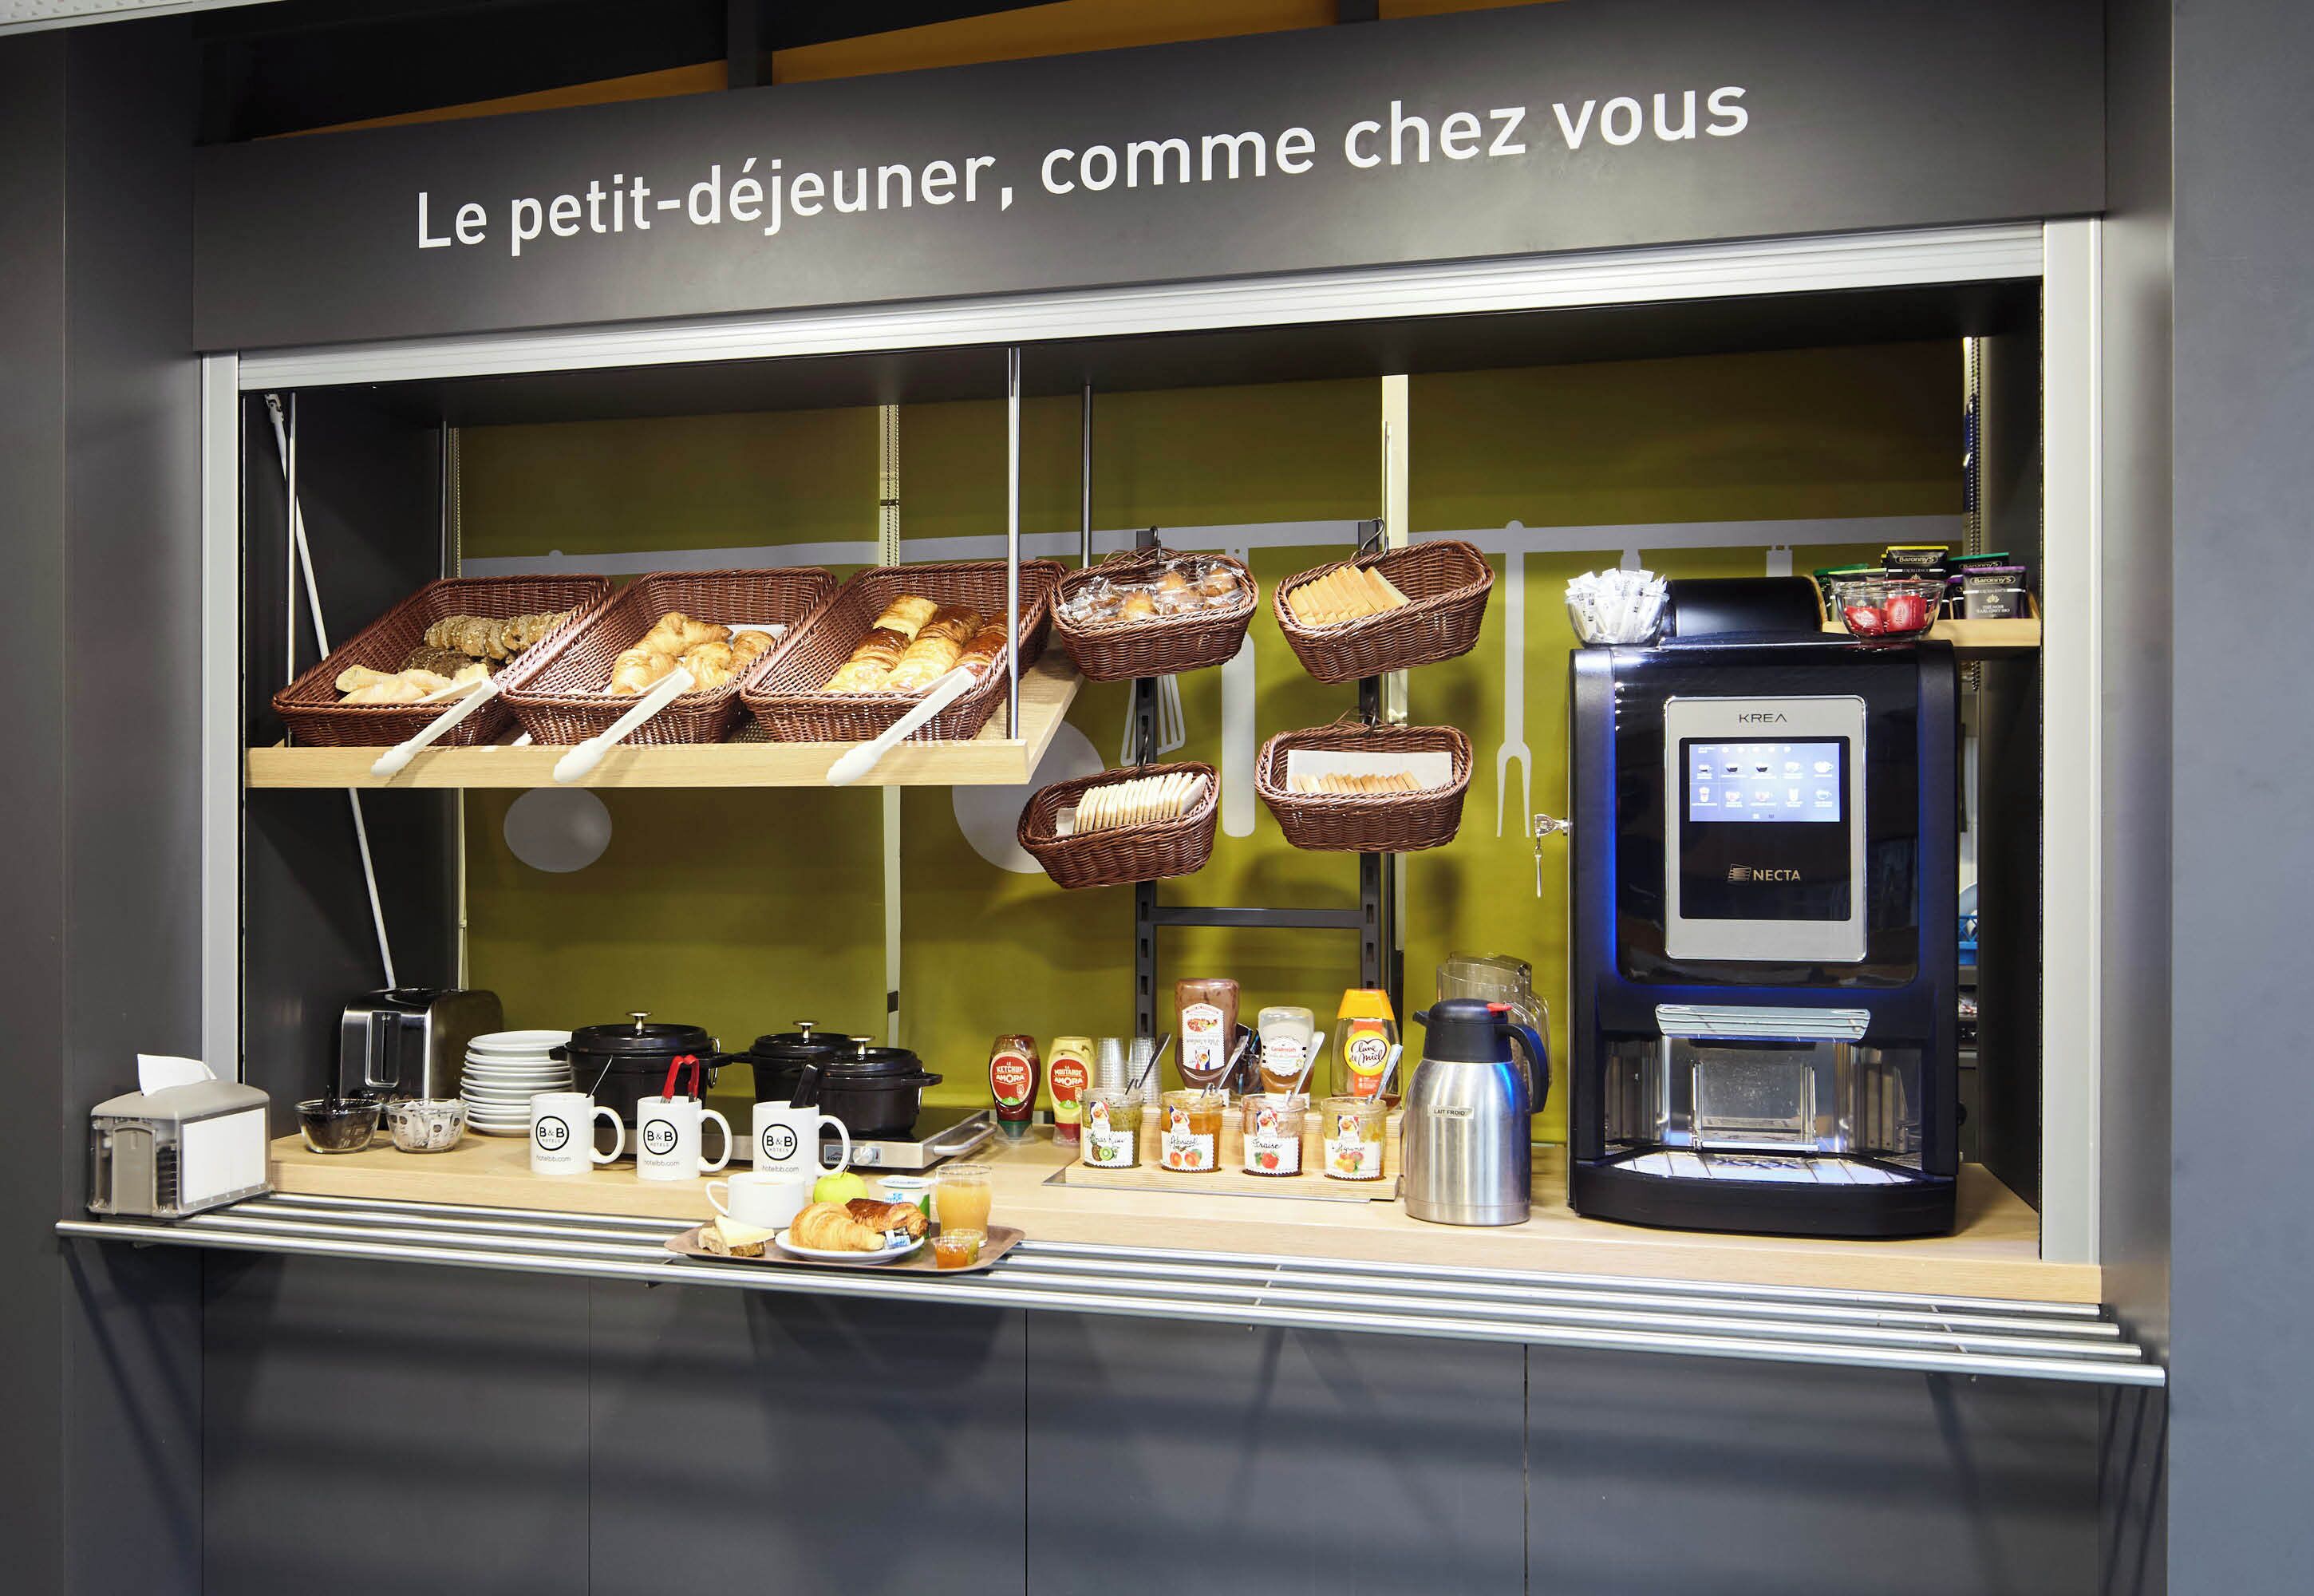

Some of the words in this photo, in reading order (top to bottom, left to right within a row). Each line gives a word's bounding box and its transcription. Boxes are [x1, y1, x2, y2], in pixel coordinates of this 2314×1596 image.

[418, 192, 487, 248] Le
[511, 156, 1013, 257] petit-déjeuner,
[1041, 127, 1316, 195] comme
[1345, 100, 1526, 168] chez
[1552, 86, 1749, 150] vous
[1739, 713, 1787, 723] KREA
[1753, 869, 1801, 881] NECTA
[996, 1074, 1025, 1084] AMORA
[1054, 1077, 1084, 1086] AMORA
[1252, 1138, 1283, 1149] Fraise
